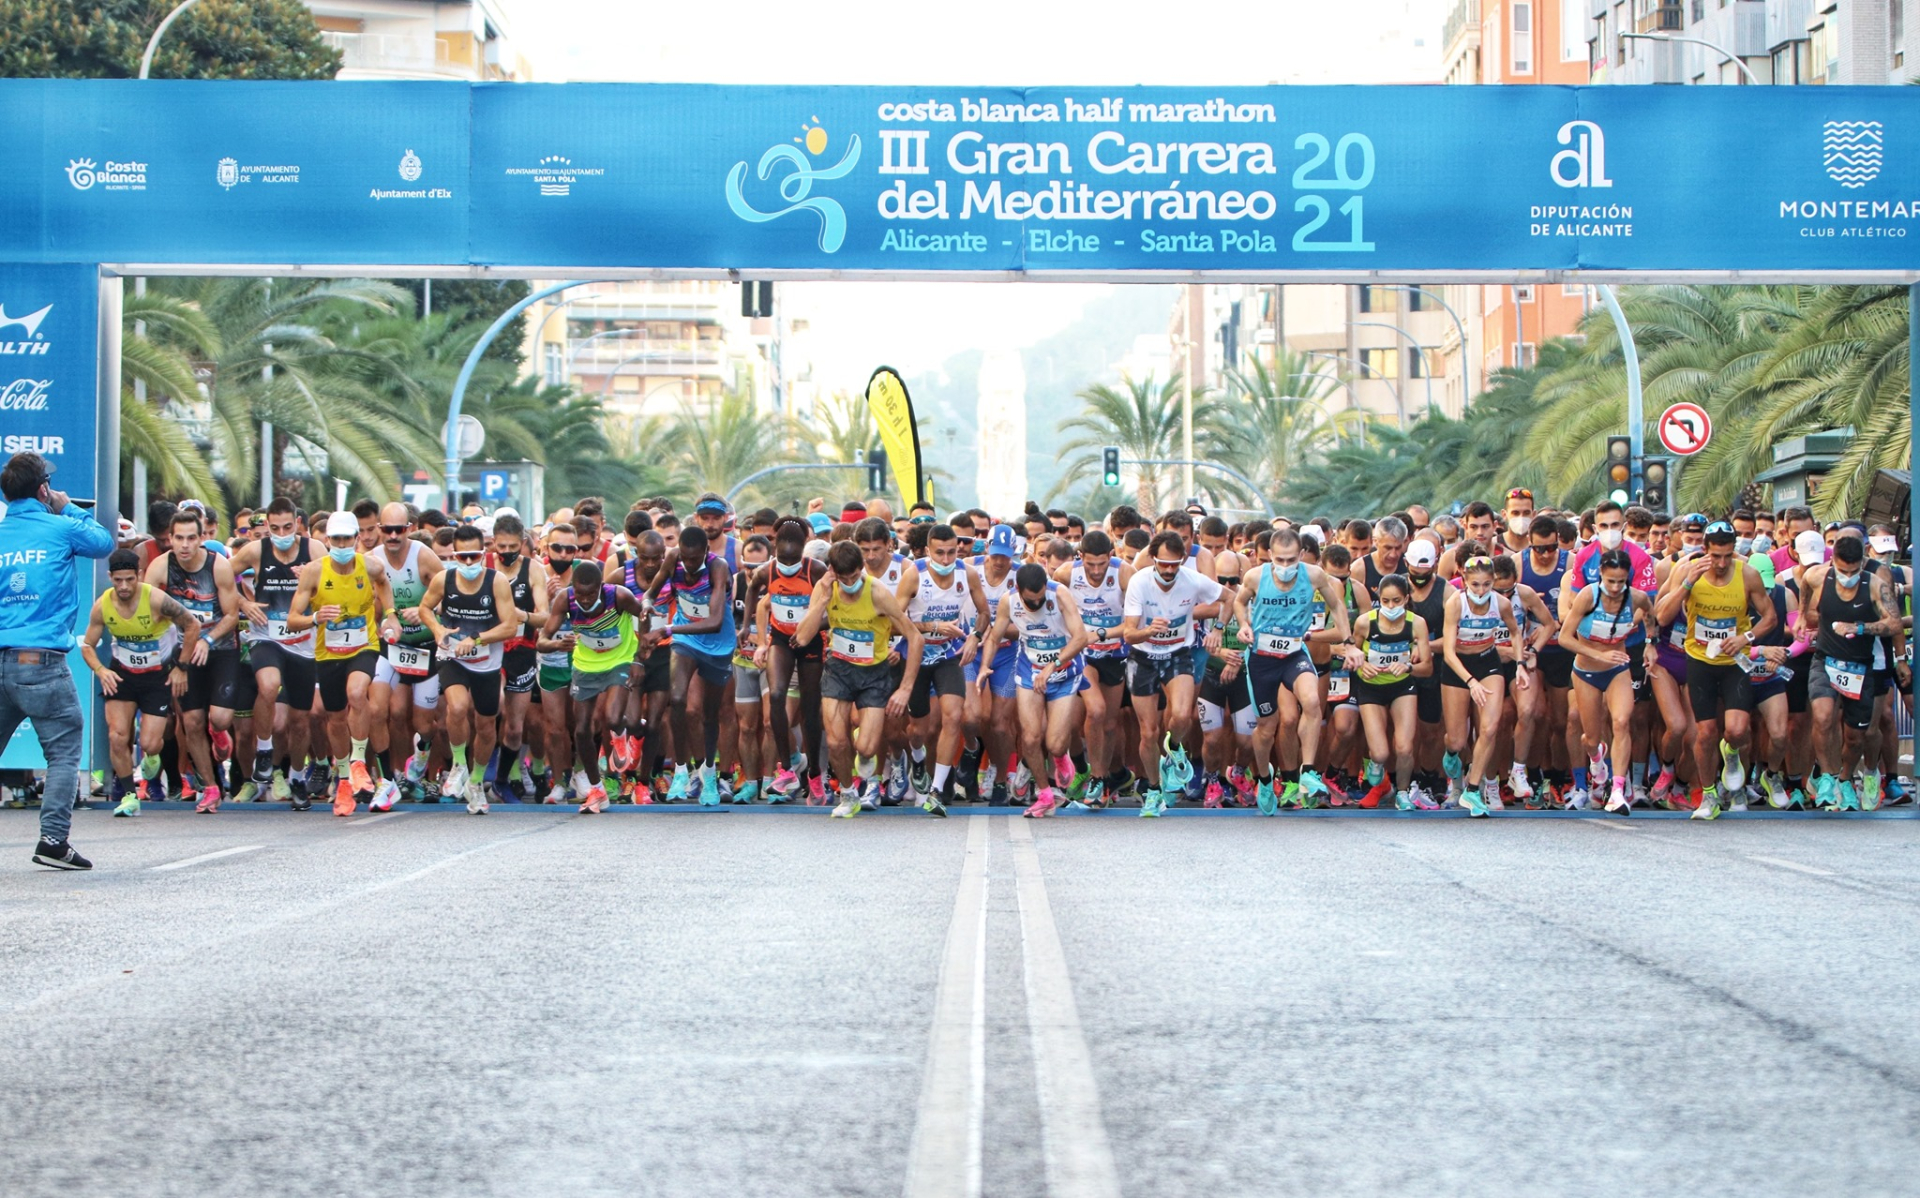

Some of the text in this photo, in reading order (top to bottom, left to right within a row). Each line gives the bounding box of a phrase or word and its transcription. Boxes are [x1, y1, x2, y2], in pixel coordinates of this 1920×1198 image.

[878, 98, 1276, 122] costa blanca half marathon
[878, 130, 1277, 175] III Gran Carrera
[105, 161, 147, 172] Costa
[1292, 132, 1375, 190] 20
[241, 165, 300, 173] AYUNTAMIENTO
[97, 172, 146, 183] Blanca
[370, 188, 451, 200] Ajuntament d'Elx
[877, 180, 1277, 220] del Mediterráneo
[1531, 203, 1632, 218] DIPUTACIÓN
[1292, 195, 1375, 251] 21
[1531, 224, 1632, 236] DE ALICANTE
[1800, 226, 1906, 237] CLUB ATLÉTICO
[880, 229, 987, 252] Alicante
[1029, 230, 1099, 252] Elche
[1141, 229, 1214, 252] Santa
[1220, 230, 1277, 252] Pola
[4, 435, 64, 454] SEUR
[486, 475, 504, 496] P
[1262, 596, 1297, 608] nerja
[693, 606, 699, 614] 2
[787, 610, 794, 619] 6
[344, 632, 350, 642] 7
[1704, 631, 1728, 640] 1540
[848, 643, 855, 653] 8
[1270, 639, 1291, 650] 462
[130, 654, 148, 665] 651
[399, 652, 418, 664] 679
[1380, 655, 1399, 665] 208
[1836, 674, 1849, 686] 63
